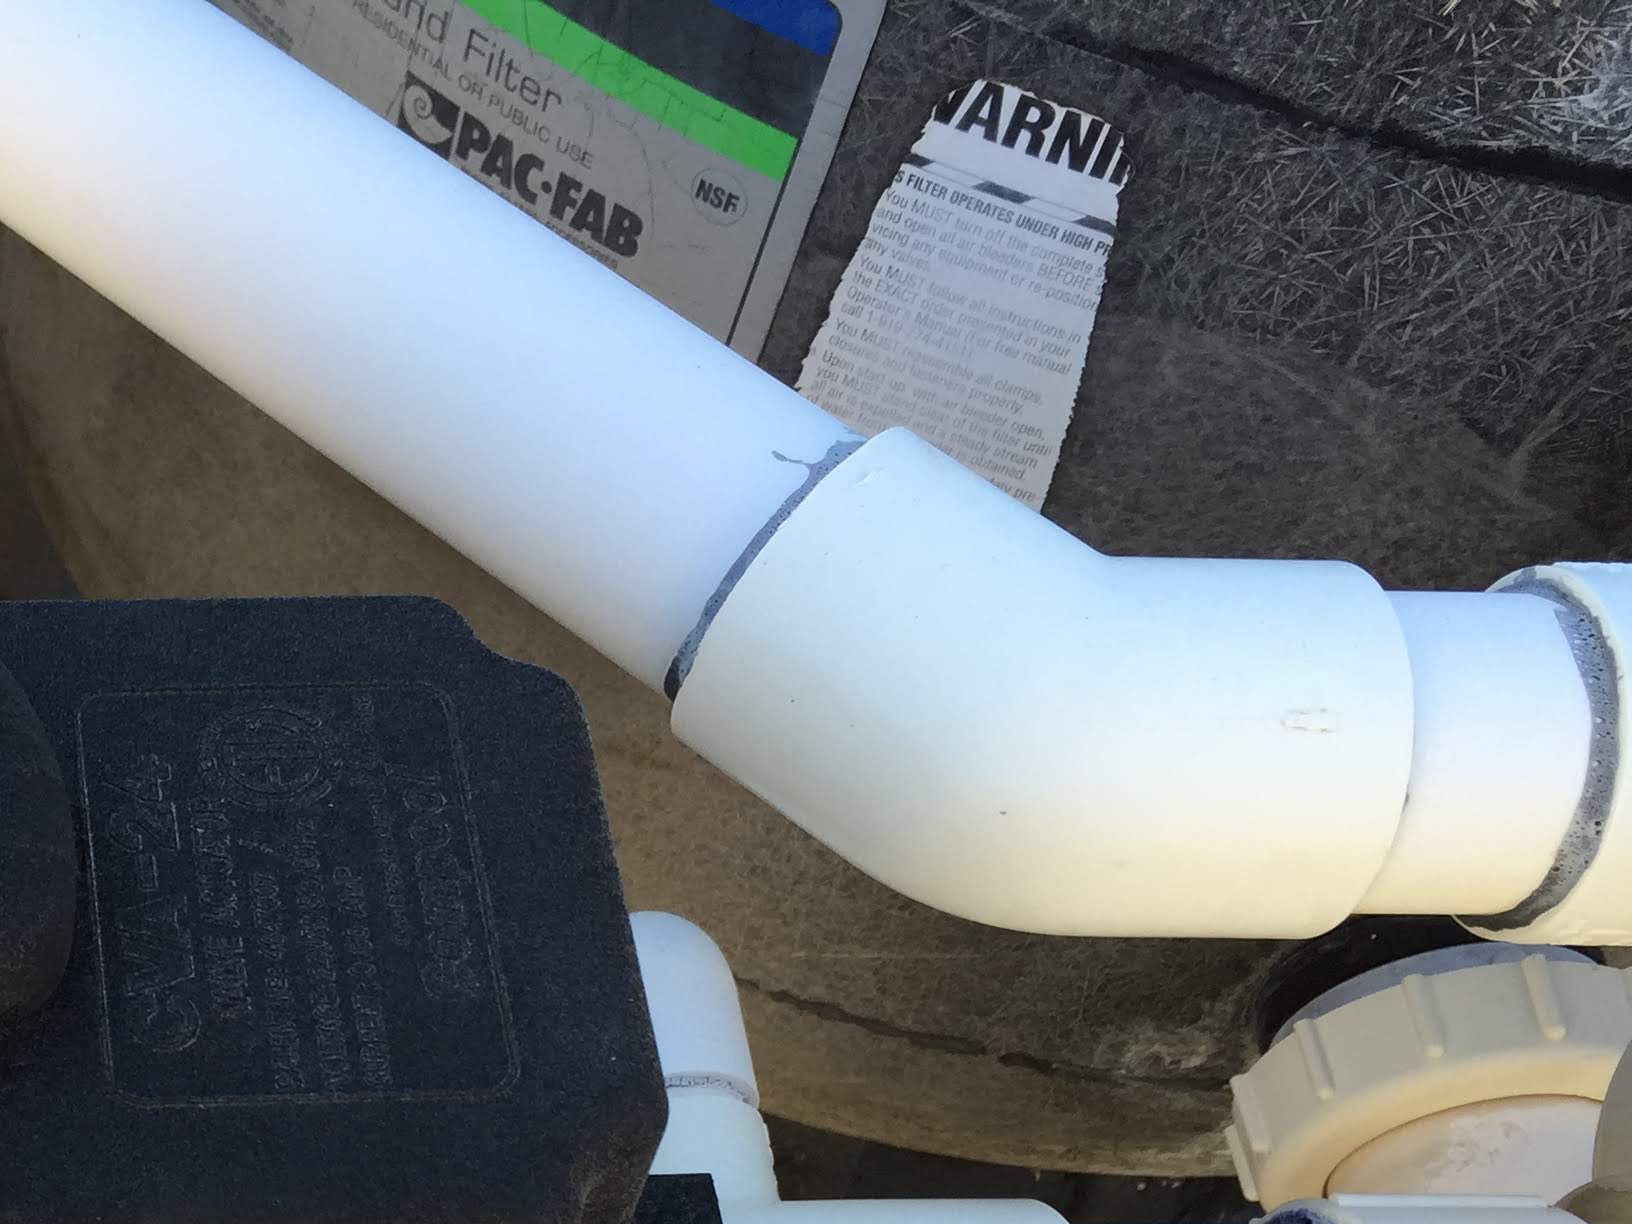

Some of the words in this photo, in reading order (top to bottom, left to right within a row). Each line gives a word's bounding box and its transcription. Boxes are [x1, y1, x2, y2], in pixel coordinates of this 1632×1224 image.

[464, 28, 562, 112] Filter
[458, 73, 484, 101] OR
[488, 97, 551, 144] PUBLIC
[556, 136, 595, 170] USE
[695, 178, 740, 213] NSF
[905, 173, 948, 200] FILTER
[948, 189, 1015, 225] OPERATES
[1014, 212, 1059, 240] UNDER
[1059, 227, 1093, 252] HIGH
[910, 197, 953, 225] MUST
[884, 264, 927, 291] MUST
[1036, 260, 1091, 292] BEFORE
